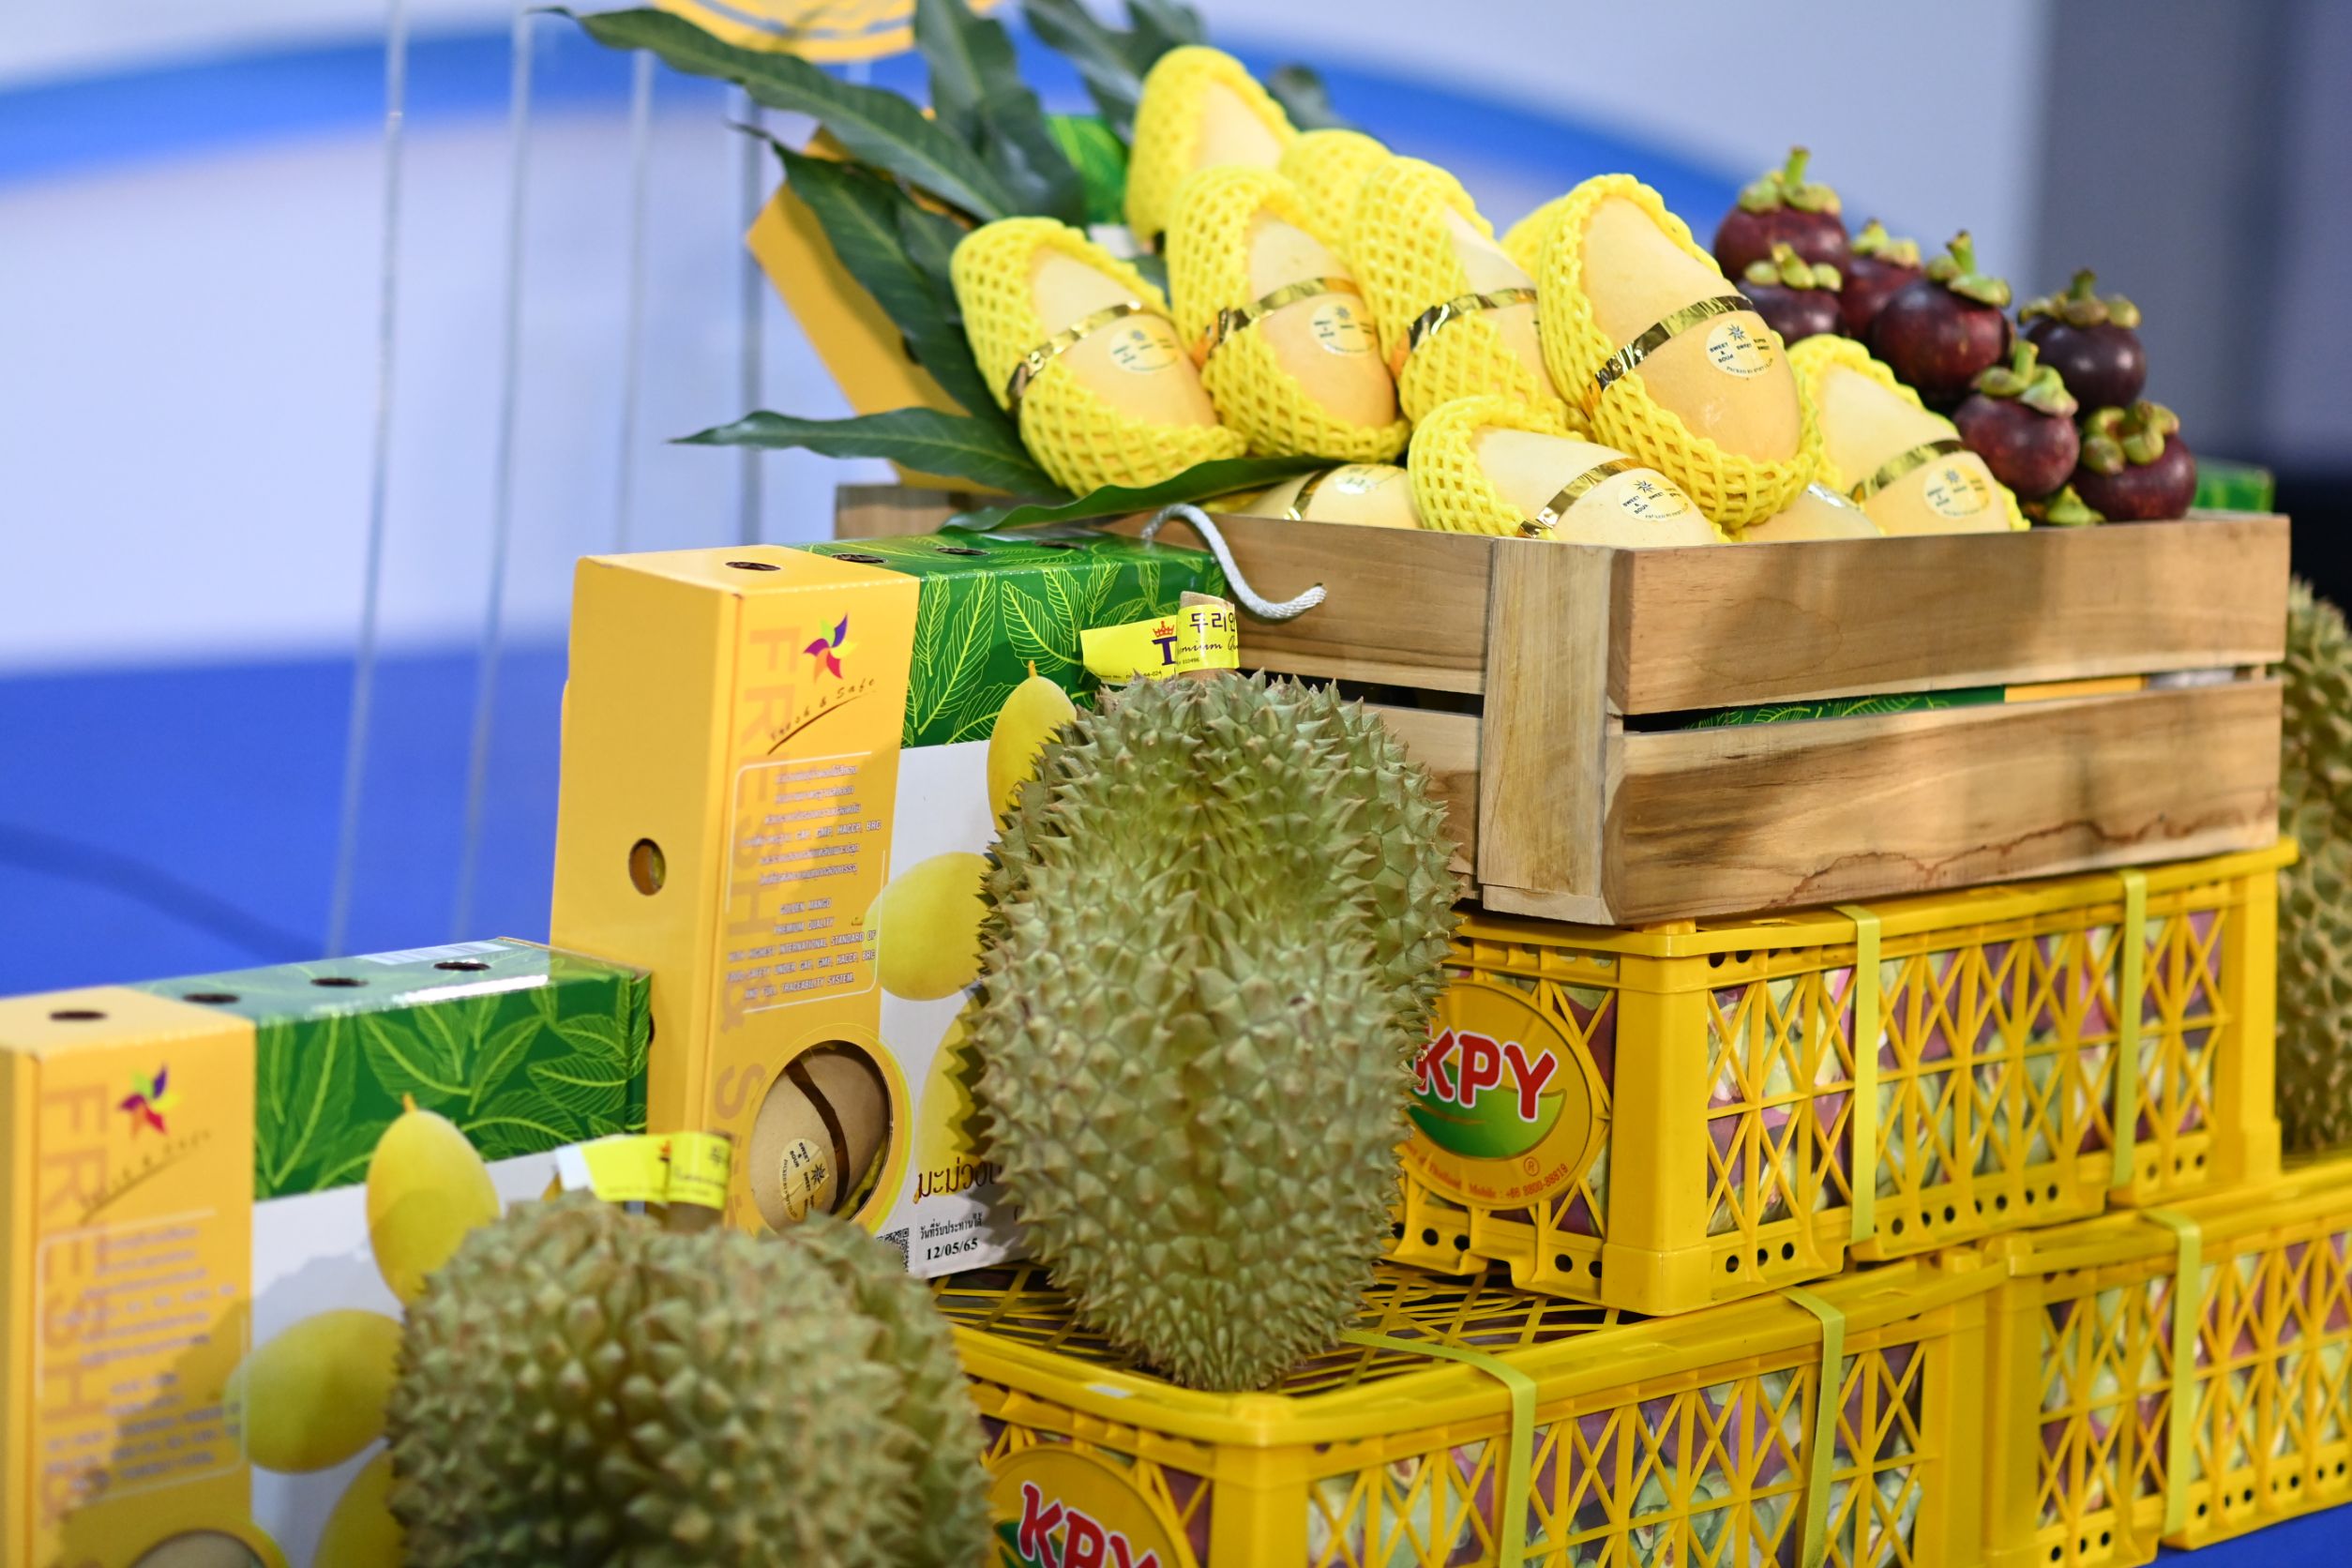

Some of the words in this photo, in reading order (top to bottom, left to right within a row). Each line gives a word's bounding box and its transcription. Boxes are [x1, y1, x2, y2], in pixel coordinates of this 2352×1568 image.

[836, 678, 875, 699] Safe
[728, 626, 803, 936] FRESH
[807, 897, 832, 911] MANGO
[807, 916, 835, 930] QUALITY
[779, 938, 828, 955] INTERNATIONAL
[830, 932, 864, 947] STANDARD
[867, 930, 877, 941] OF
[782, 977, 825, 992] TRACEABILITY
[827, 972, 855, 985] SYSTEM.
[1413, 1027, 1558, 1122] KPY
[789, 1150, 800, 1168] SOUR
[798, 1141, 810, 1163] SWEET
[920, 1212, 983, 1240] วันที่รับประทานได้
[927, 1237, 978, 1260] 12/05/65
